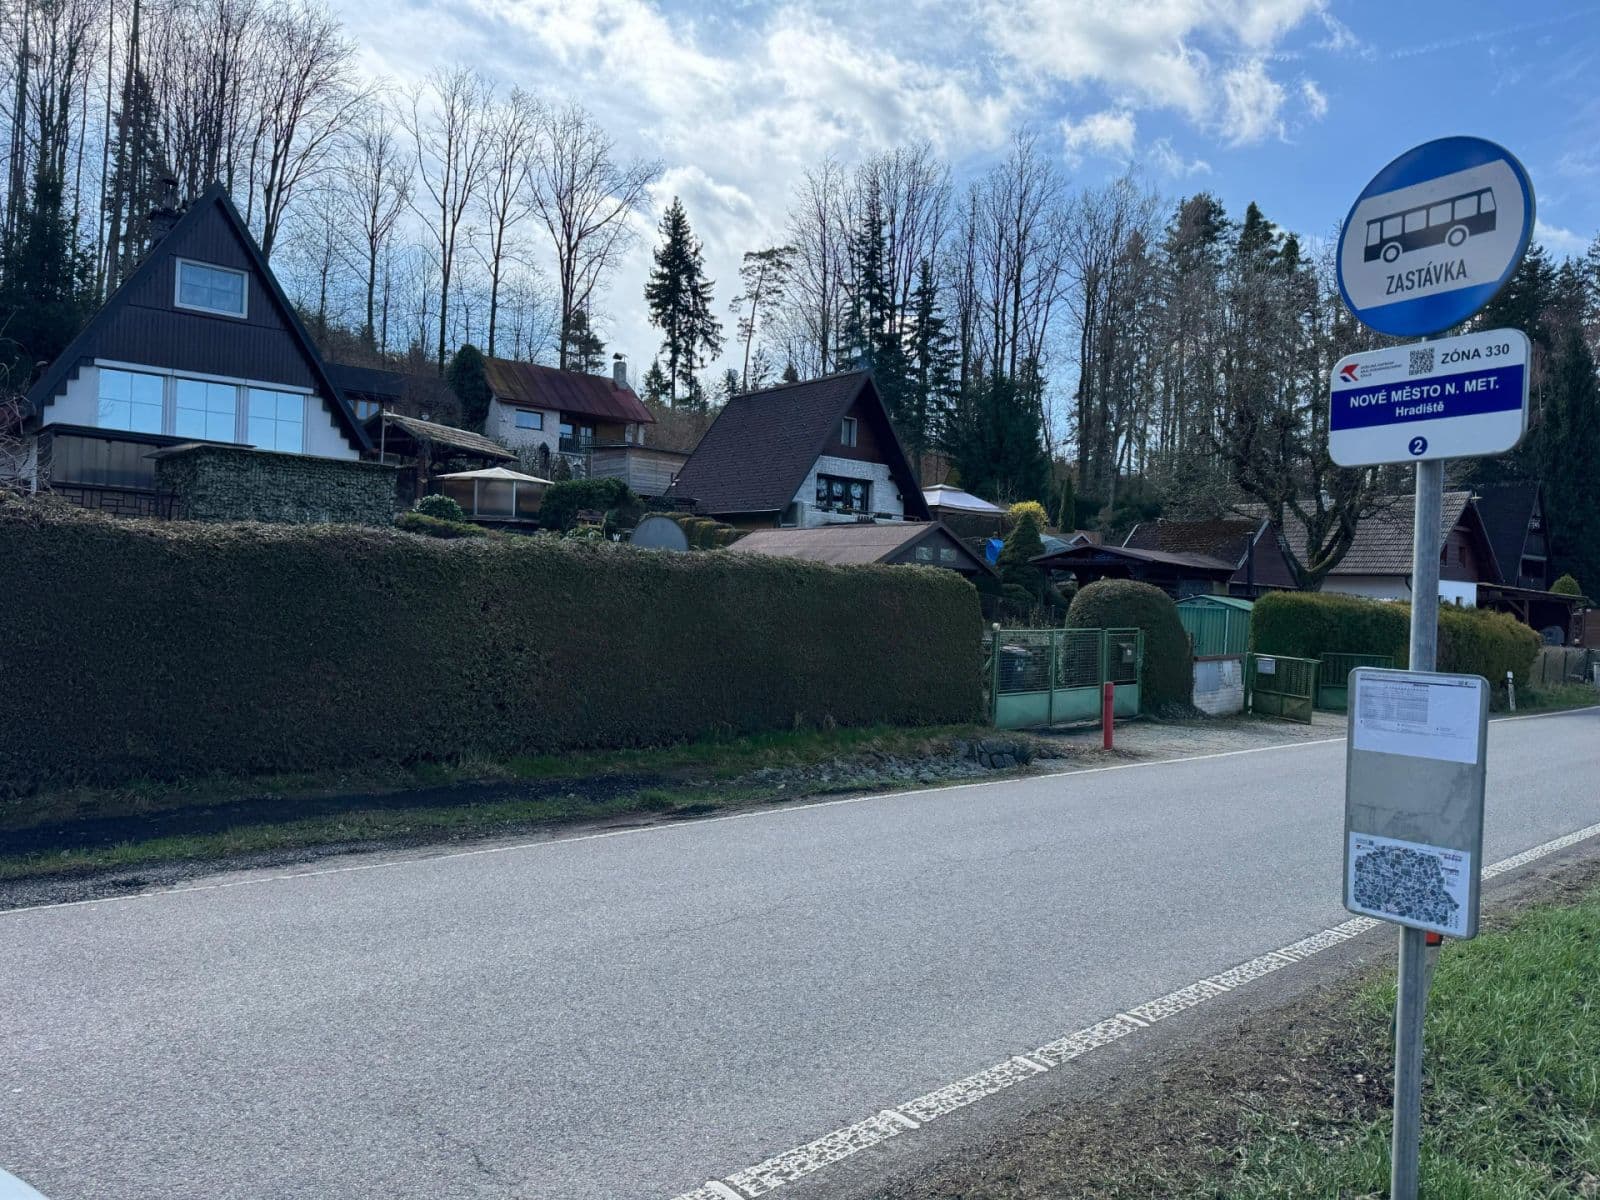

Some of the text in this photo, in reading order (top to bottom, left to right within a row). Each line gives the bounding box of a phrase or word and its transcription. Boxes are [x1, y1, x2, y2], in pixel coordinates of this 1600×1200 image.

[1386, 259, 1467, 295] ZASTÁVKA
[1441, 343, 1510, 364] ZÓNA 330
[1350, 377, 1500, 408] NOVÉ MĚSTO N. MET.
[1395, 401, 1444, 417] Hradiště
[1413, 439, 1423, 453] 2
